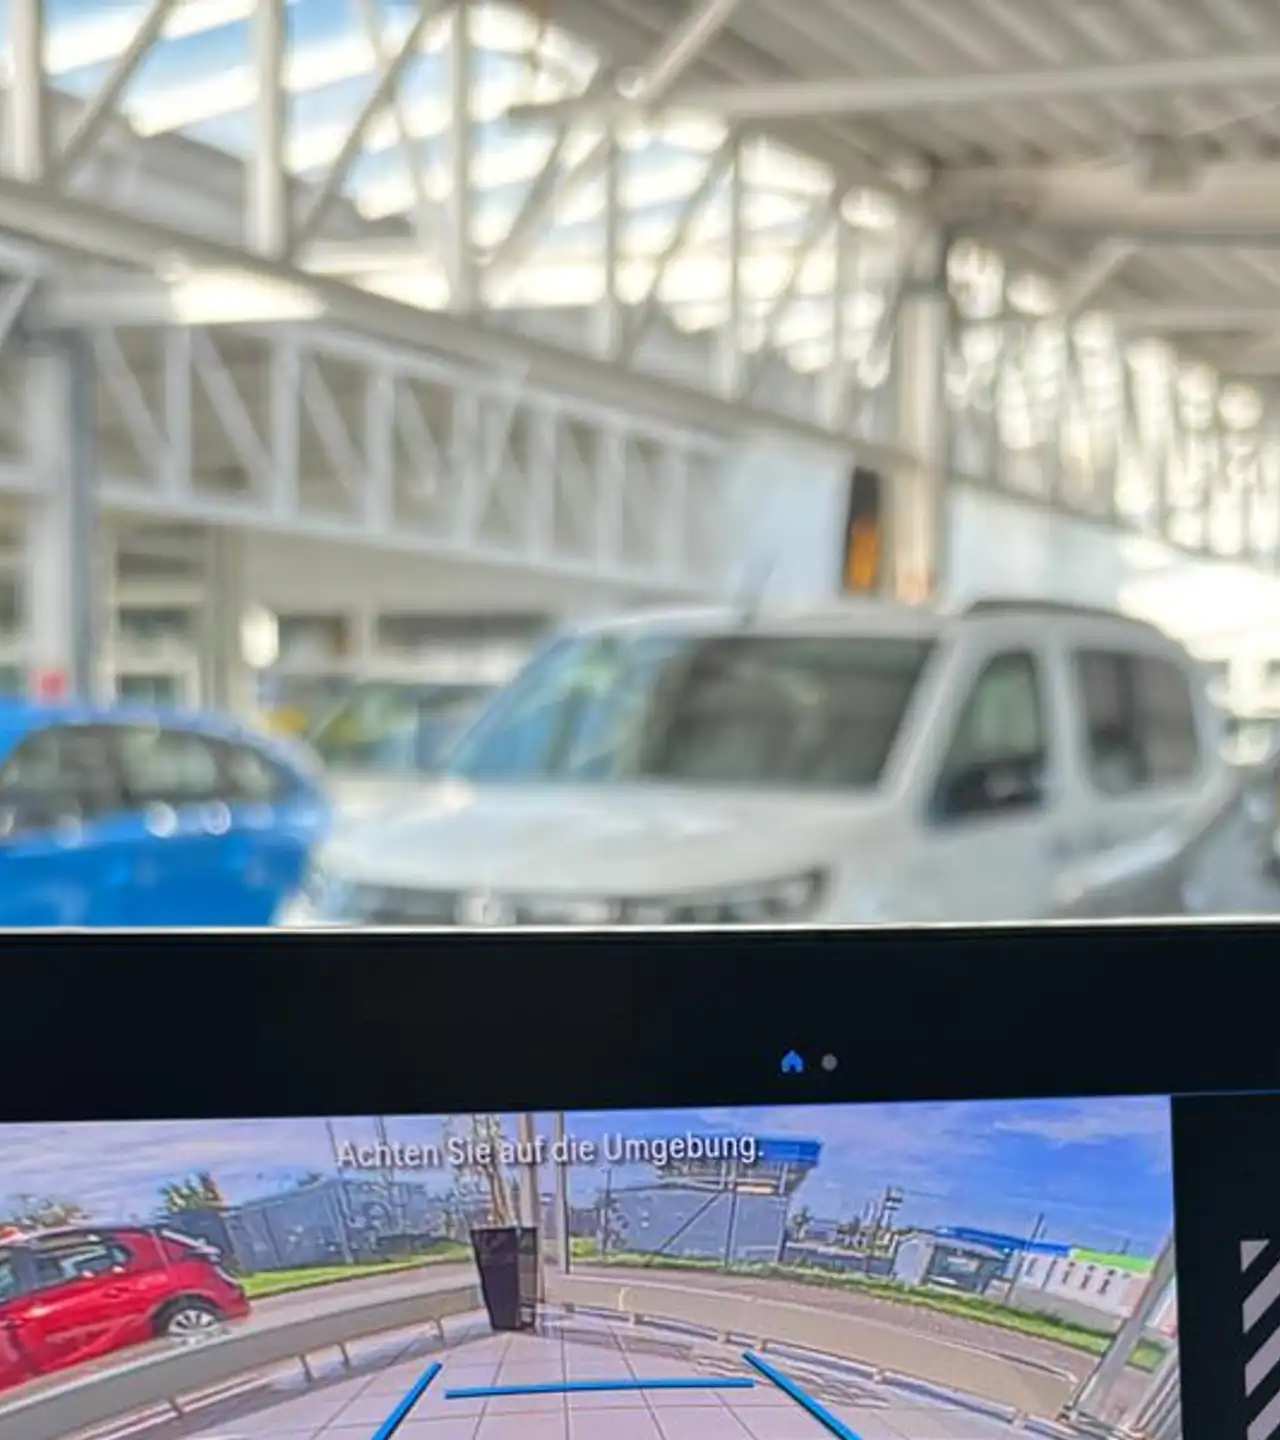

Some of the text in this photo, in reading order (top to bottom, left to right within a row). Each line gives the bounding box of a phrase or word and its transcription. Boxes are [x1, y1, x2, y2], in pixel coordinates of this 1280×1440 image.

[336, 1132, 764, 1168] Achten Sie auf die Umgebung.
